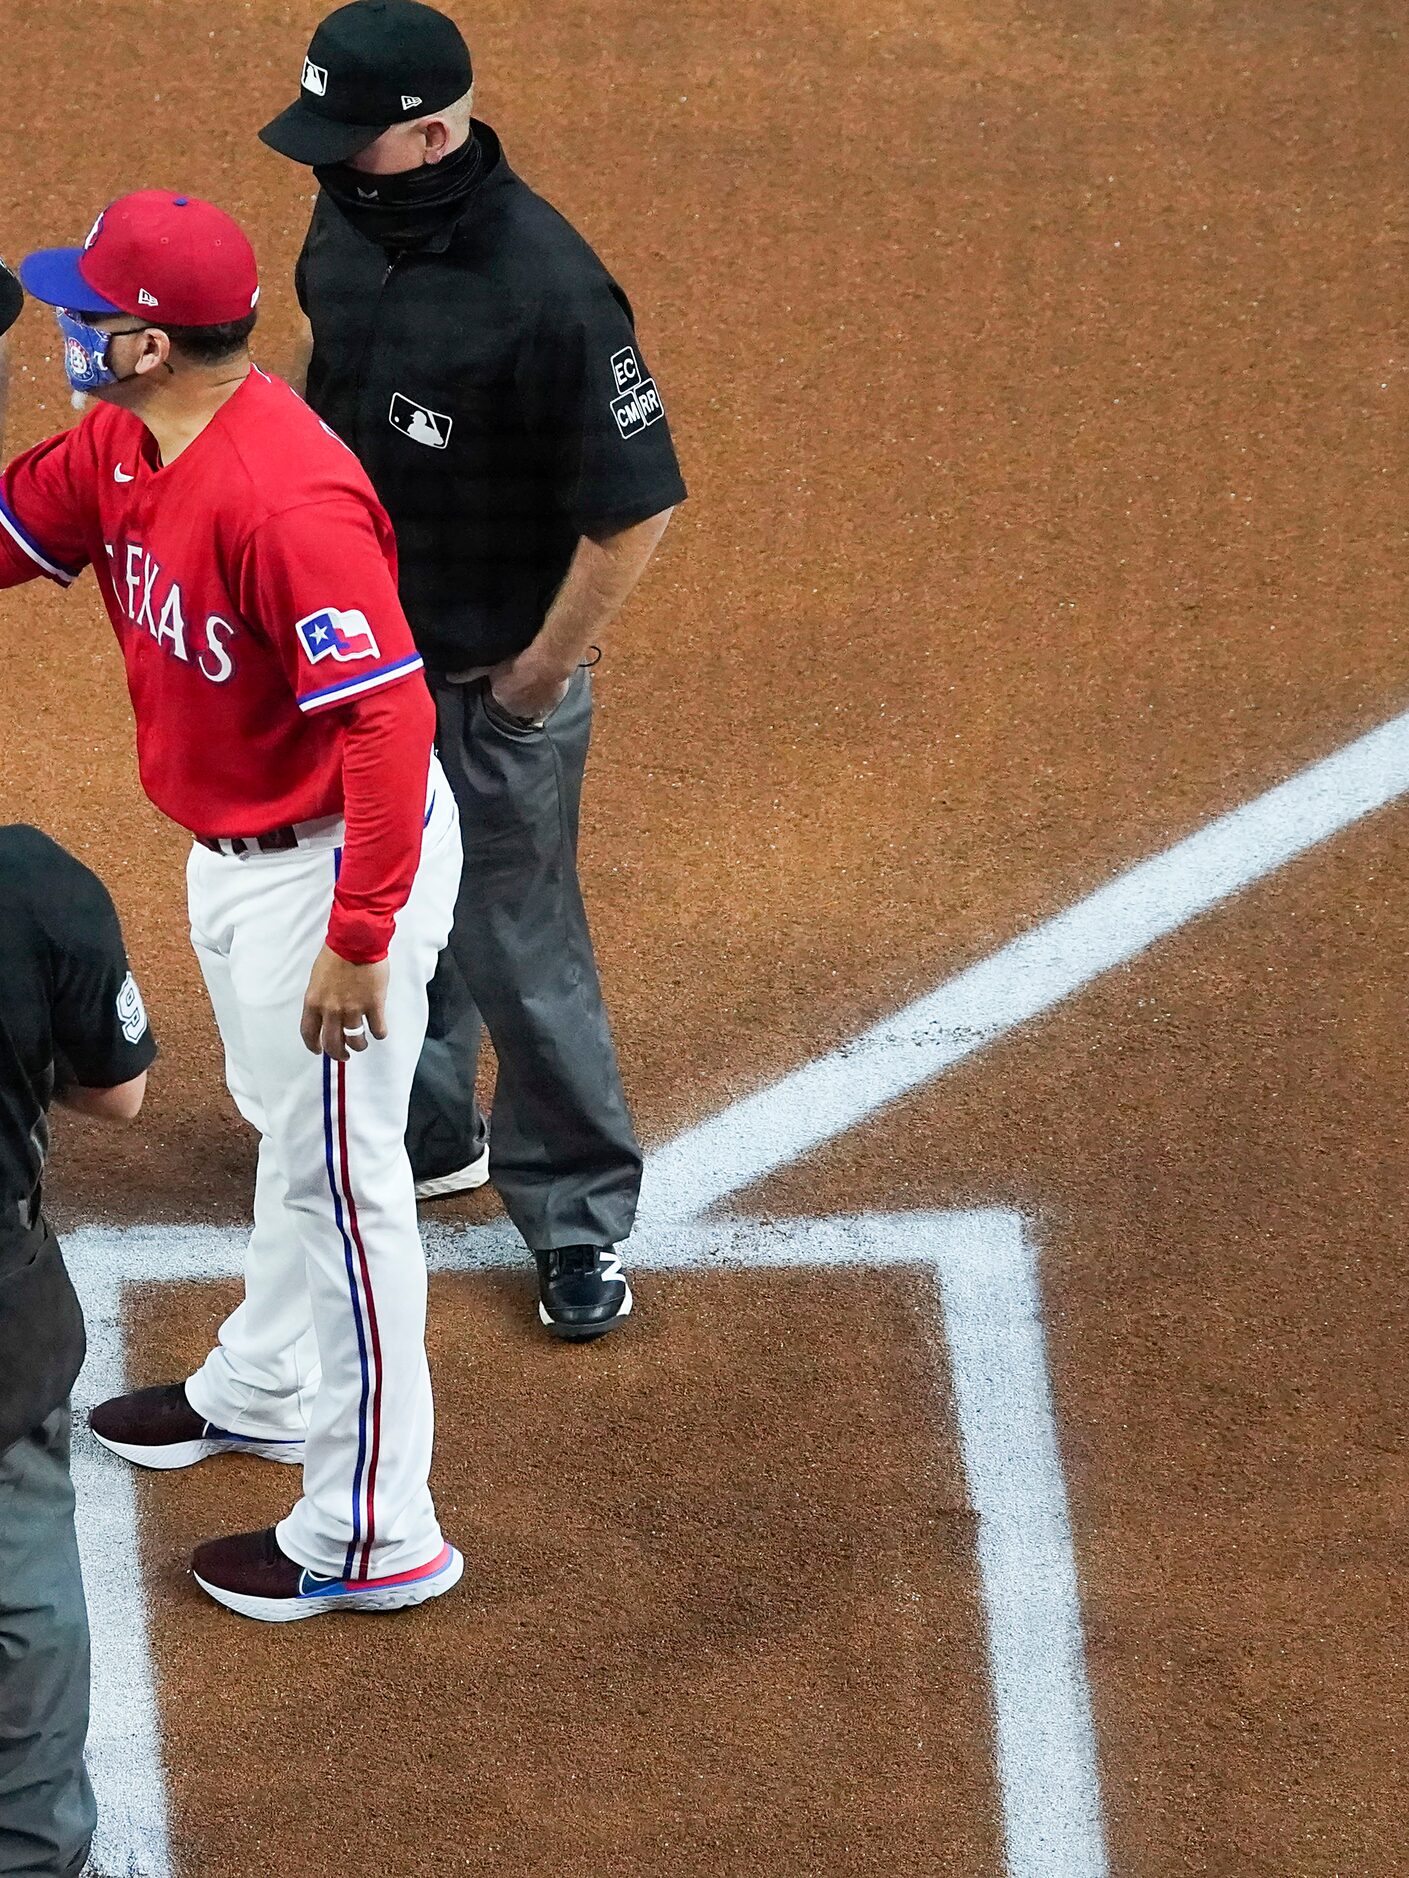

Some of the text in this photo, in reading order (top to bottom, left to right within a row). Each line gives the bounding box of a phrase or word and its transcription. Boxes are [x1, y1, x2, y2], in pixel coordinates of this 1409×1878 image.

[614, 357, 636, 386] EC
[616, 389, 660, 427] CM RR
